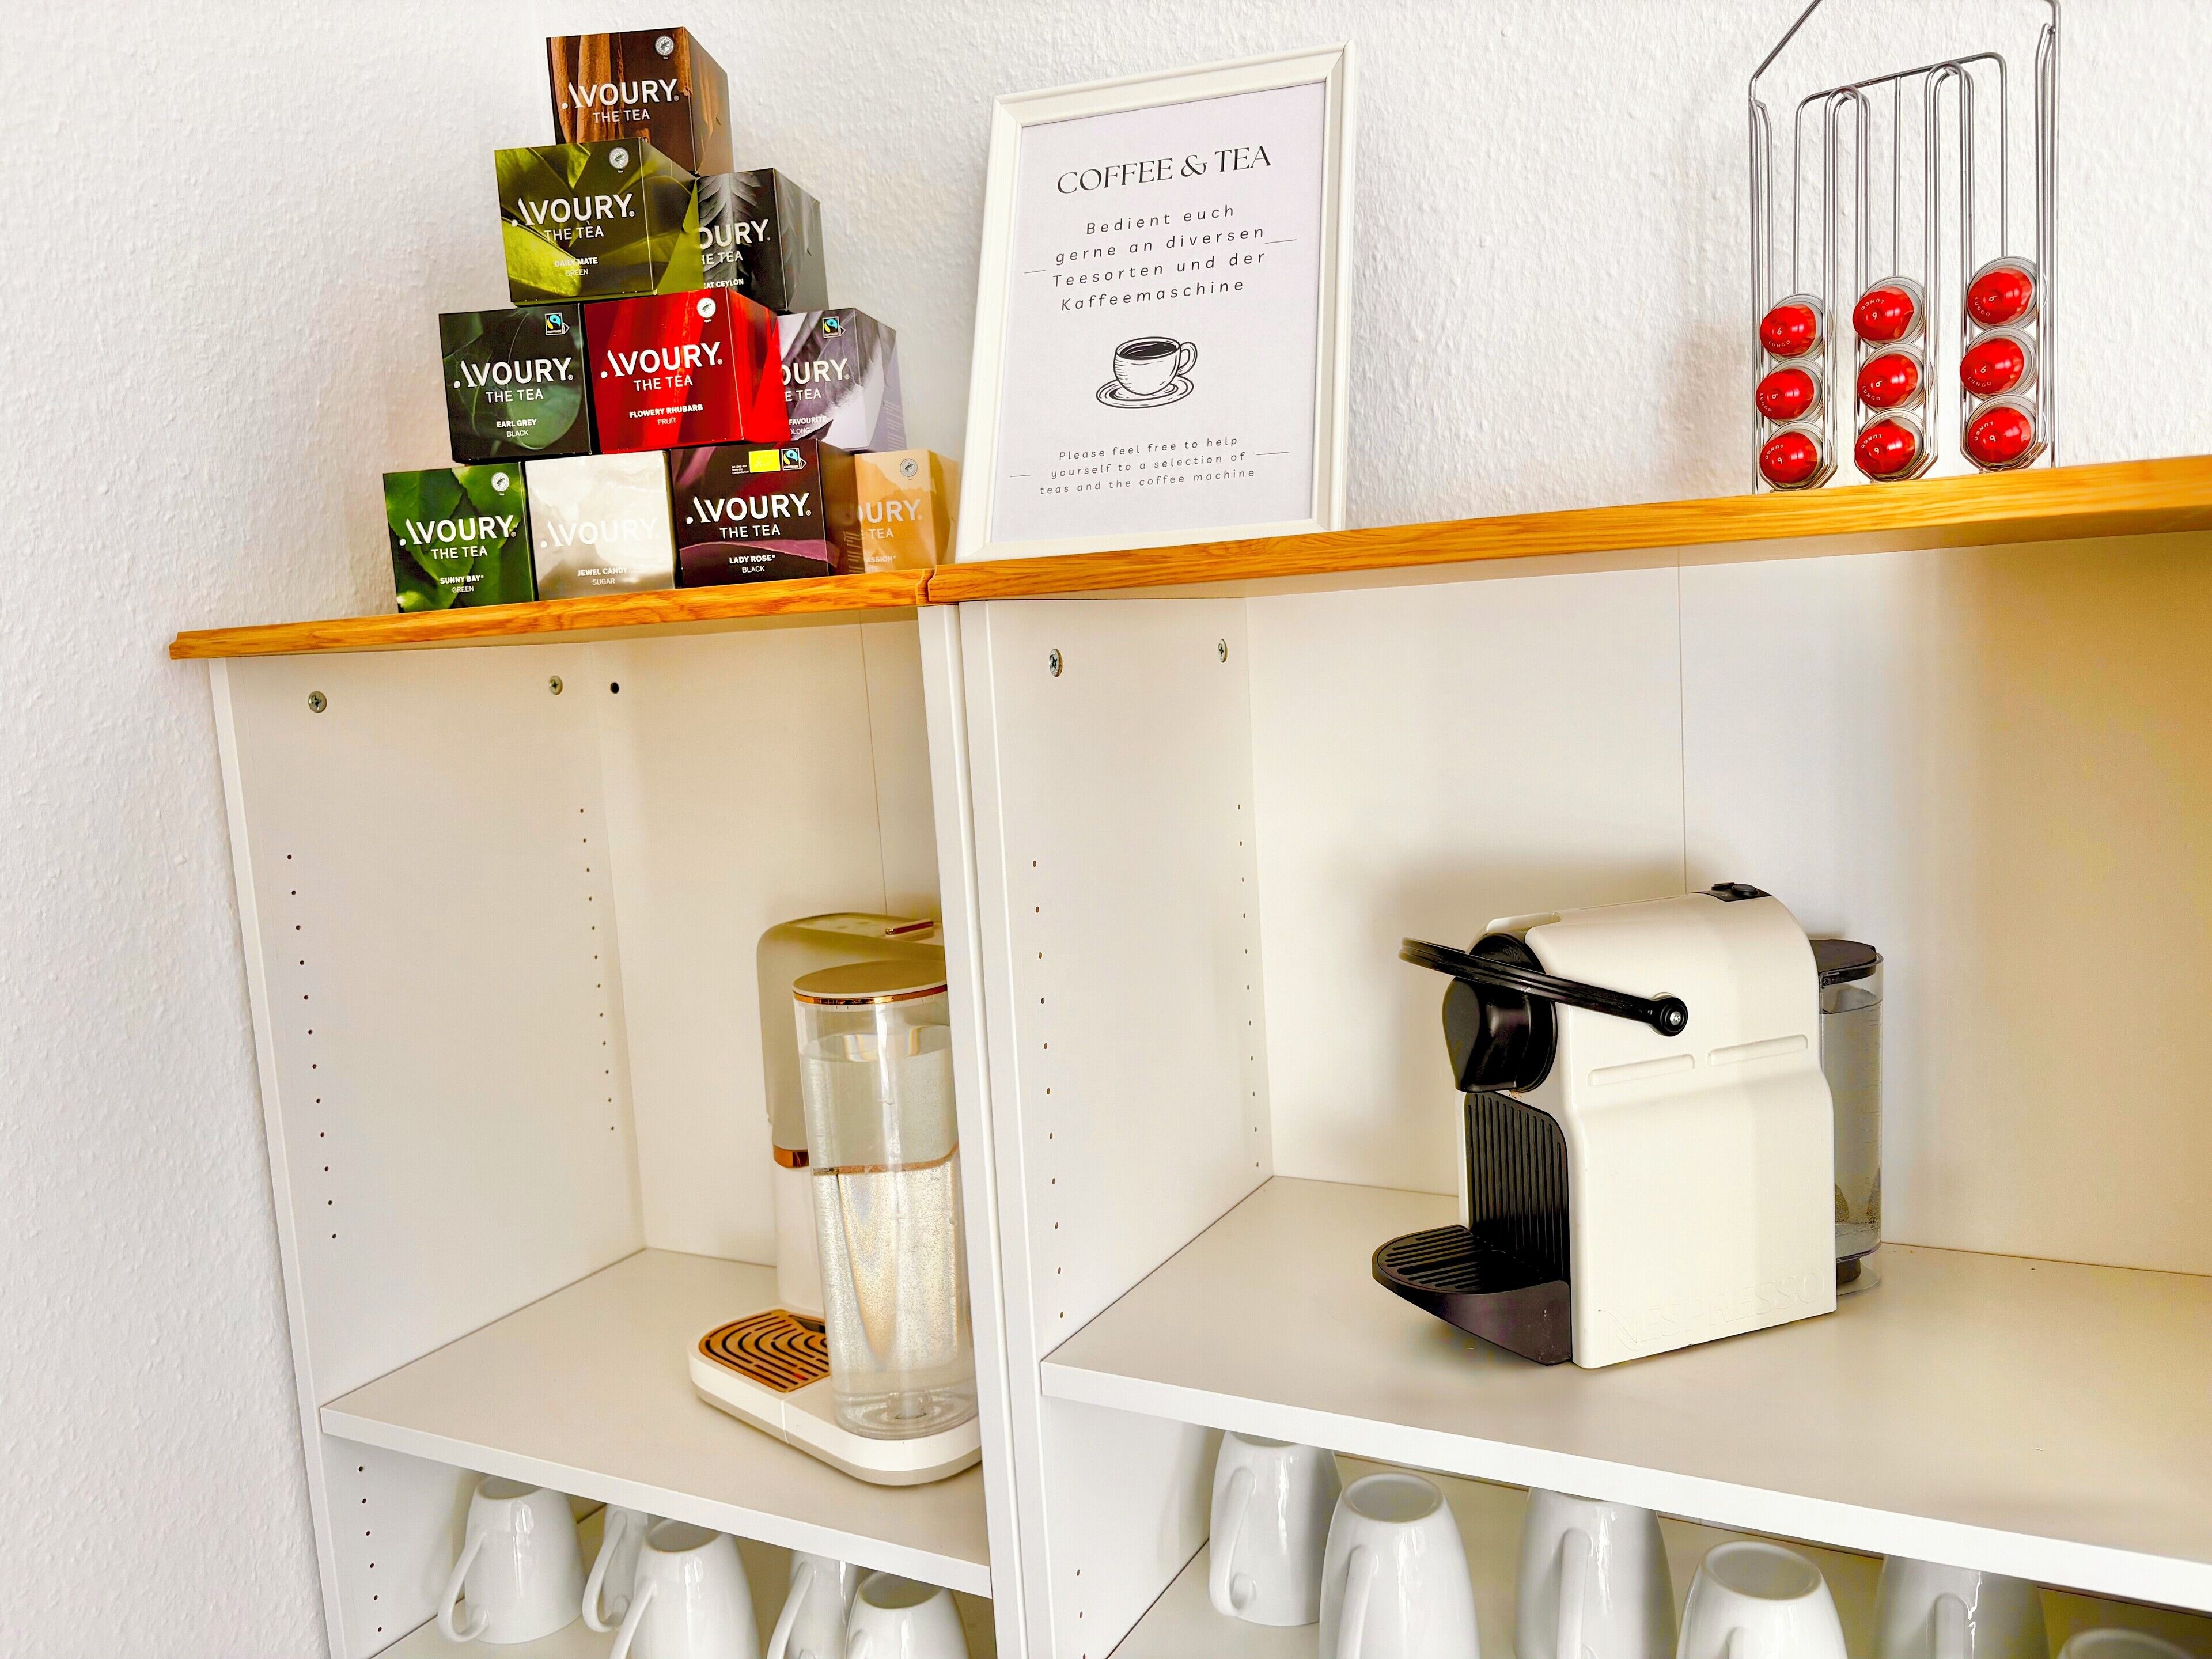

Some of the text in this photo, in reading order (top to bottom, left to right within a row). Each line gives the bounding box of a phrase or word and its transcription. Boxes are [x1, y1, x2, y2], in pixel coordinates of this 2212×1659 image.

[593, 109, 650, 123] THE TEA
[1057, 145, 1272, 194] COFFEE & TEA
[1086, 204, 1233, 235] Bedient euch
[544, 226, 604, 241] THE TEA
[1056, 228, 1263, 266] gerne an diversen
[555, 257, 598, 267] DAILY MATE
[718, 250, 743, 263] TEA
[565, 268, 589, 276] GREEN
[1052, 252, 1264, 287] Teesorten und der
[715, 278, 744, 288] CEYLON
[1062, 281, 1243, 311] Kaffeemaschine
[1861, 298, 1884, 310] LUNGO
[1974, 297, 1990, 316] LUNGO
[634, 374, 693, 391] THE TEA
[1968, 377, 1991, 387] LUNGO
[485, 388, 544, 403] THE TEA
[796, 388, 821, 401] TEA
[1862, 385, 1880, 401] LUNGO
[1760, 393, 1772, 412] LUNGO
[629, 404, 703, 418] FLOWERY RHUBARB
[496, 419, 537, 428] EARL GREY
[657, 417, 677, 425] FRUIT
[789, 415, 828, 425] FAVOURITE
[1974, 421, 1993, 441] LUNGO
[1059, 436, 1237, 461] Please feel free to help
[1861, 434, 1882, 449] LUNGO
[1765, 444, 1783, 459] LUNGO
[1051, 463, 1111, 480] yourself
[1154, 455, 1222, 468] selection
[1230, 451, 1245, 461] of
[1040, 469, 1254, 494] teas and the coffee machine
[719, 524, 781, 539] THE TEA
[869, 528, 894, 540] TEA
[431, 545, 488, 560] THE TEA
[729, 556, 749, 564] LADY
[603, 566, 628, 575] CANDY
[440, 576, 465, 584] SUNNY
[452, 585, 474, 593] GREEN
